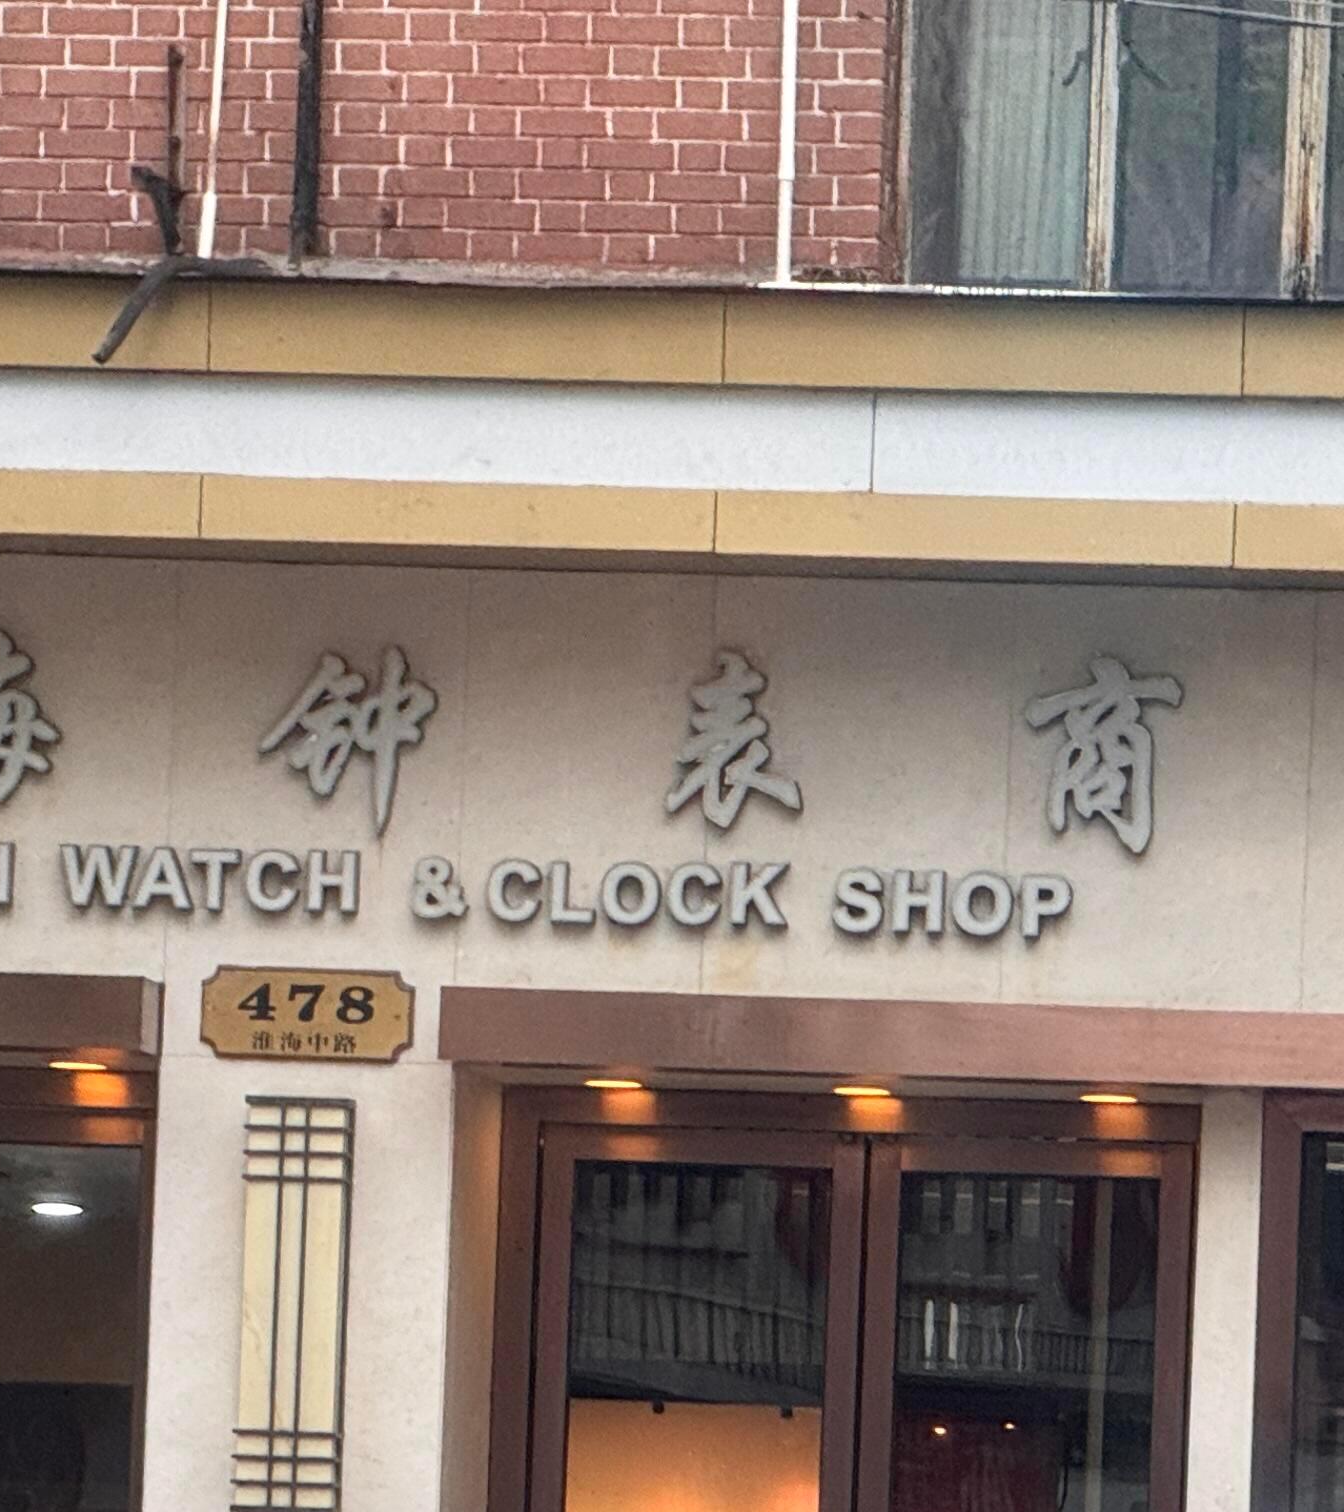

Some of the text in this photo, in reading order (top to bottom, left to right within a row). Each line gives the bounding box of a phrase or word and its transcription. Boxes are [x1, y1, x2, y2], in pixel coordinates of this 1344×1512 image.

[60, 843, 362, 915] WATCH
[412, 857, 468, 920] &
[487, 857, 791, 930] CLOCK
[830, 868, 1073, 938] SHOP
[236, 982, 375, 1025] 478
[251, 1030, 357, 1054] 淮海中路
